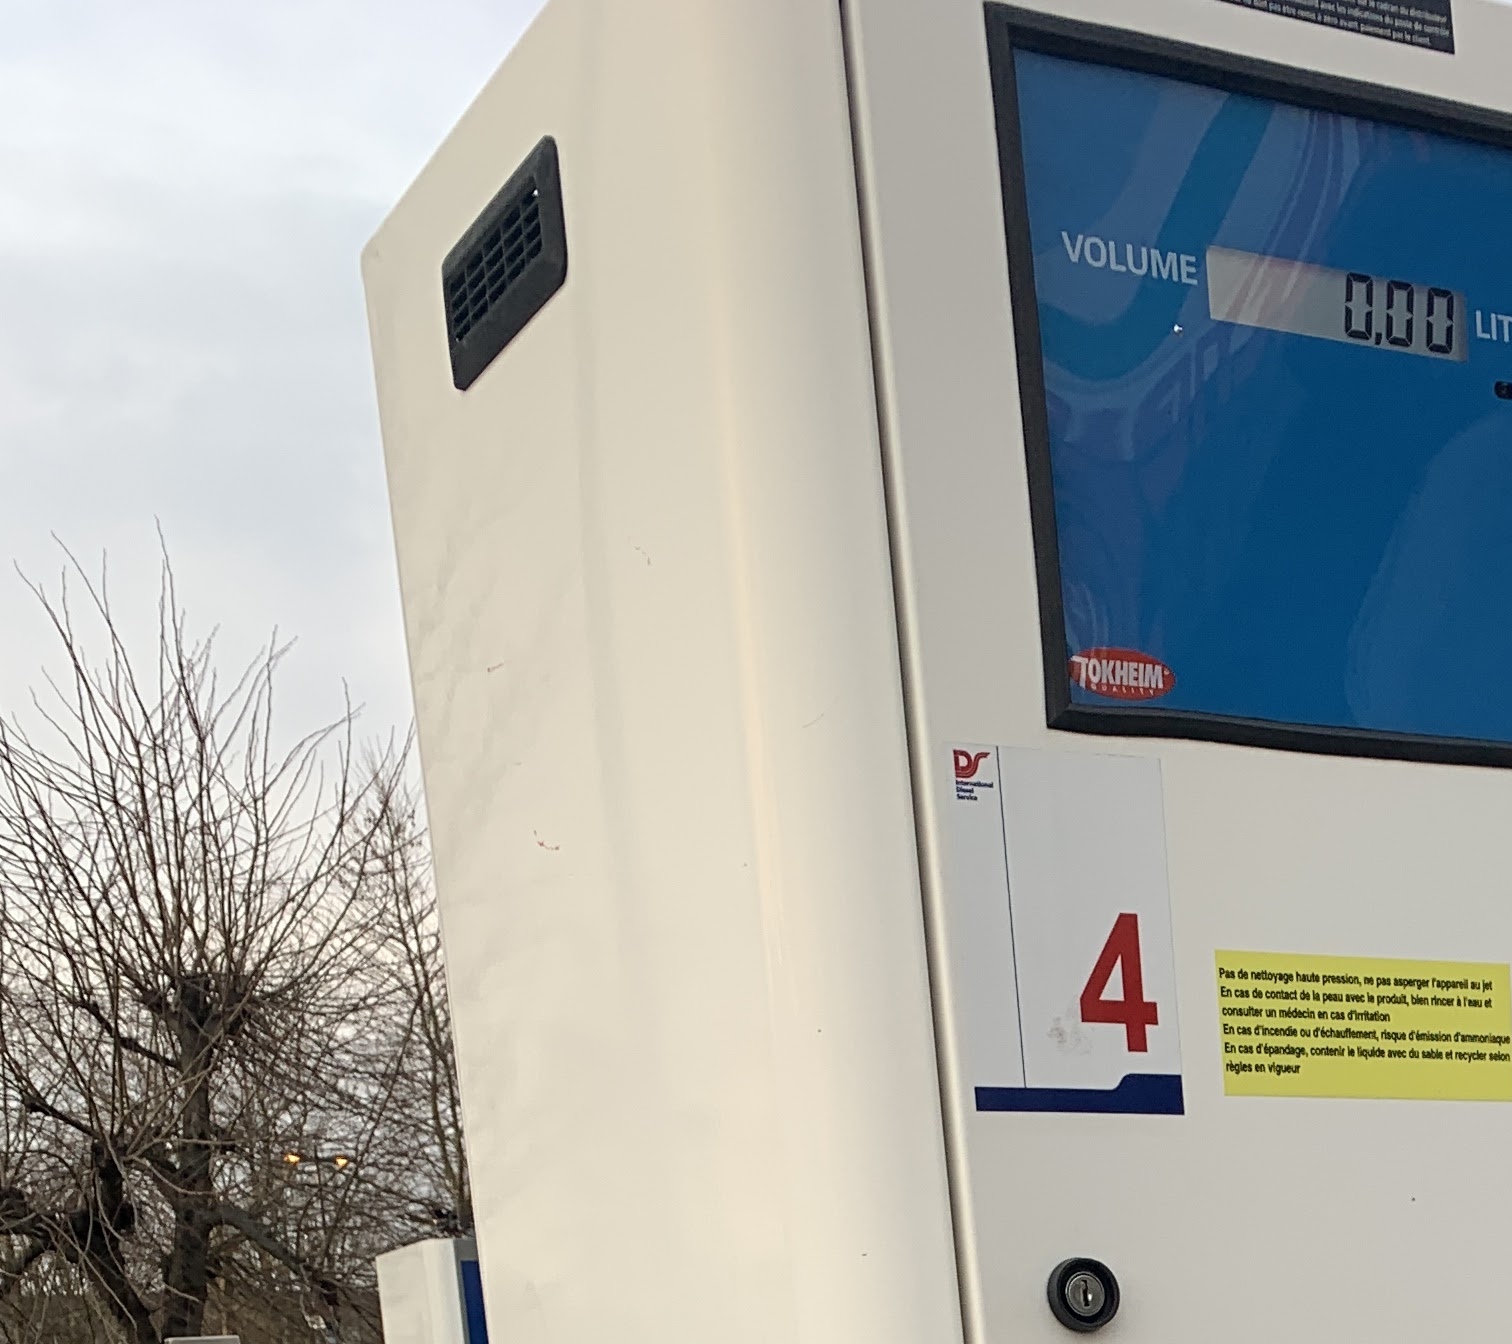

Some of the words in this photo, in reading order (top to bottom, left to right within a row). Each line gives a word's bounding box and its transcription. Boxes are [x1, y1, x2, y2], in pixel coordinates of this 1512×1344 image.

[1061, 231, 1198, 286] VOLUME
[1344, 272, 1454, 354] 0,00
[1070, 655, 1164, 690] TOKHEIM
[1090, 683, 1155, 696] QUALITY
[1080, 912, 1159, 1053] 4
[1218, 967, 1236, 980] Pas
[1238, 968, 1249, 980] de
[1251, 970, 1294, 985] nettoyage
[1295, 971, 1320, 983] haute
[1322, 973, 1362, 987] pression,
[1363, 977, 1374, 986] ne
[1376, 977, 1391, 988] pas
[1393, 978, 1430, 990] asperger
[1470, 981, 1480, 990] au
[1482, 979, 1493, 993] jet
[1220, 986, 1232, 998] En
[1234, 989, 1249, 998] cas
[1252, 988, 1263, 999] de
[1265, 989, 1297, 1001] contact
[1299, 990, 1311, 1001] de
[1312, 990, 1321, 1002] la
[1322, 993, 1343, 1004] peau
[1345, 994, 1366, 1003] avec
[1367, 992, 1375, 1003] le
[1376, 994, 1409, 1007] produit,
[1411, 994, 1429, 1006] bien
[1430, 995, 1455, 1007] rincer
[1456, 996, 1462, 1007] à
[1484, 998, 1493, 1008] et
[1222, 1005, 1263, 1018] consulter
[1265, 1008, 1277, 1018] un
[1279, 1007, 1316, 1019] médecin
[1317, 1010, 1329, 1020] en
[1330, 1011, 1345, 1020] cas
[1223, 1023, 1235, 1035] En
[1236, 1026, 1252, 1036] cas
[1254, 1024, 1298, 1037] d'incendie
[1299, 1028, 1311, 1038] ou
[1380, 1029, 1407, 1043] risque
[1224, 1042, 1236, 1054] En
[1238, 1045, 1254, 1055] cas
[1310, 1045, 1346, 1057] contenir
[1347, 1045, 1355, 1057] le
[1356, 1045, 1386, 1060] liquide
[1387, 1049, 1407, 1059] avec
[1408, 1047, 1419, 1059] du
[1421, 1048, 1443, 1060] sable
[1445, 1049, 1453, 1060] et
[1454, 1050, 1487, 1063] recycler
[1488, 1051, 1511, 1062] selon
[1225, 1060, 1253, 1075] règles
[1254, 1063, 1266, 1073] en
[1267, 1062, 1301, 1076] vigueur
